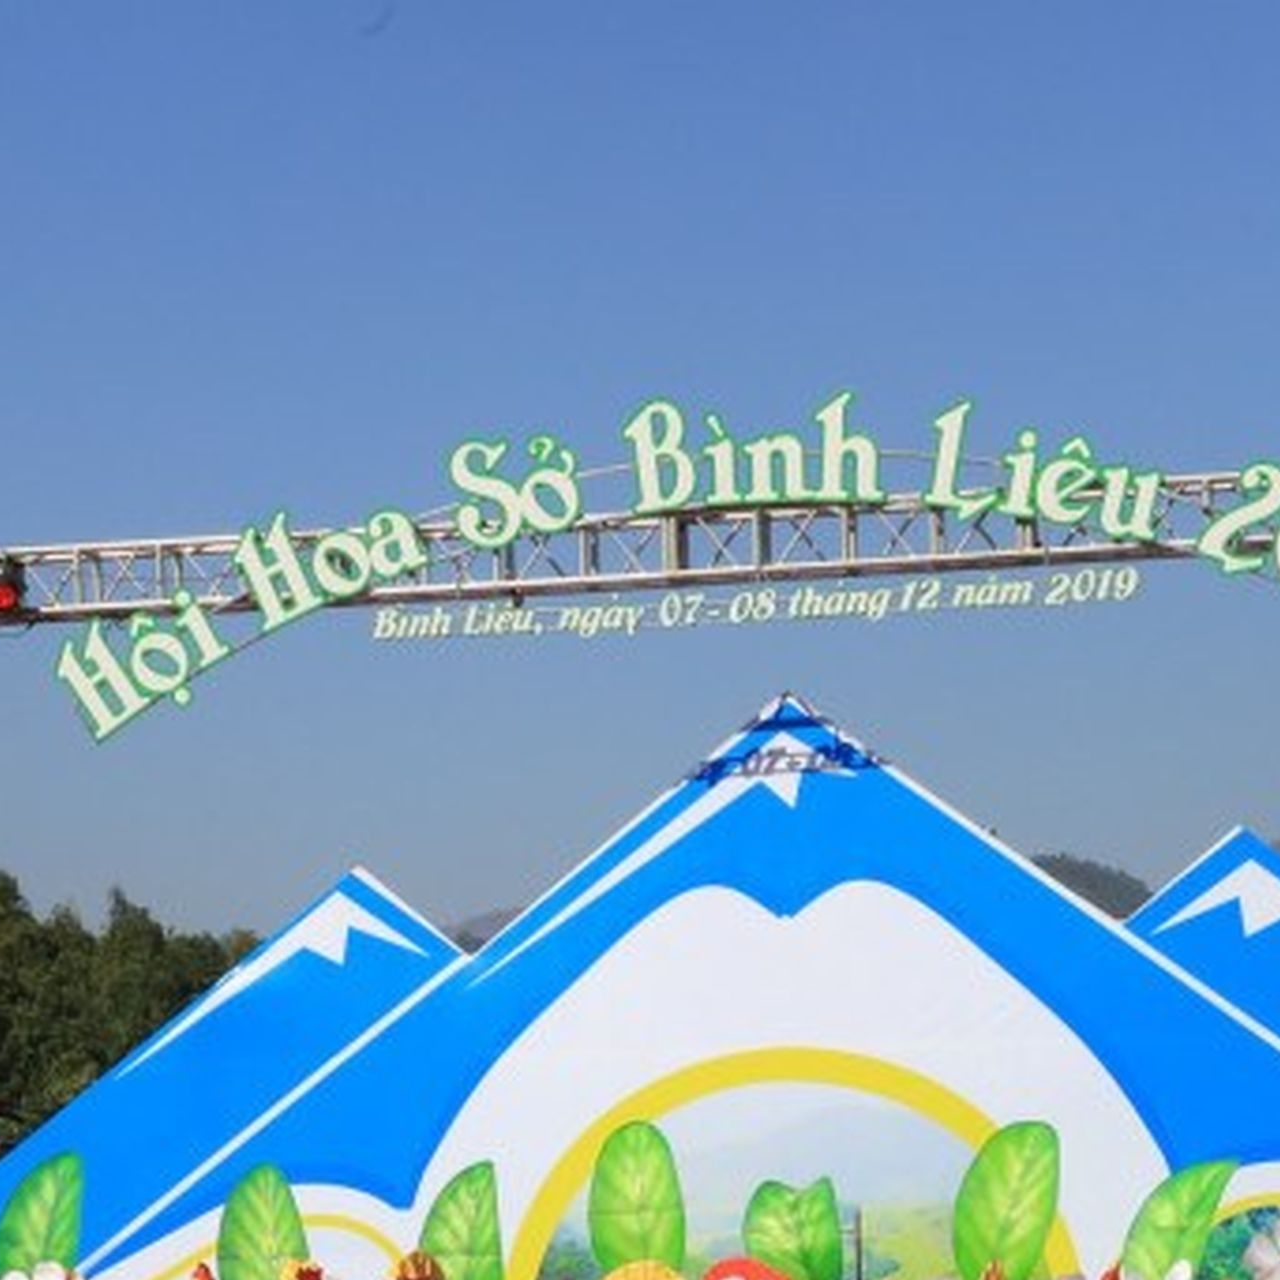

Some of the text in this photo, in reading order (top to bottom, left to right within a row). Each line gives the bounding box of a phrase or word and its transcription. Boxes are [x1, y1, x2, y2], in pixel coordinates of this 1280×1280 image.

[56, 590, 230, 743] Hội
[232, 511, 428, 632] Hoa
[448, 435, 583, 550] Sở
[623, 391, 886, 514] Bình
[923, 397, 1168, 543] Liêu
[787, 579, 890, 619] tháng
[898, 579, 940, 611] 12
[1043, 565, 1141, 606] 2019
